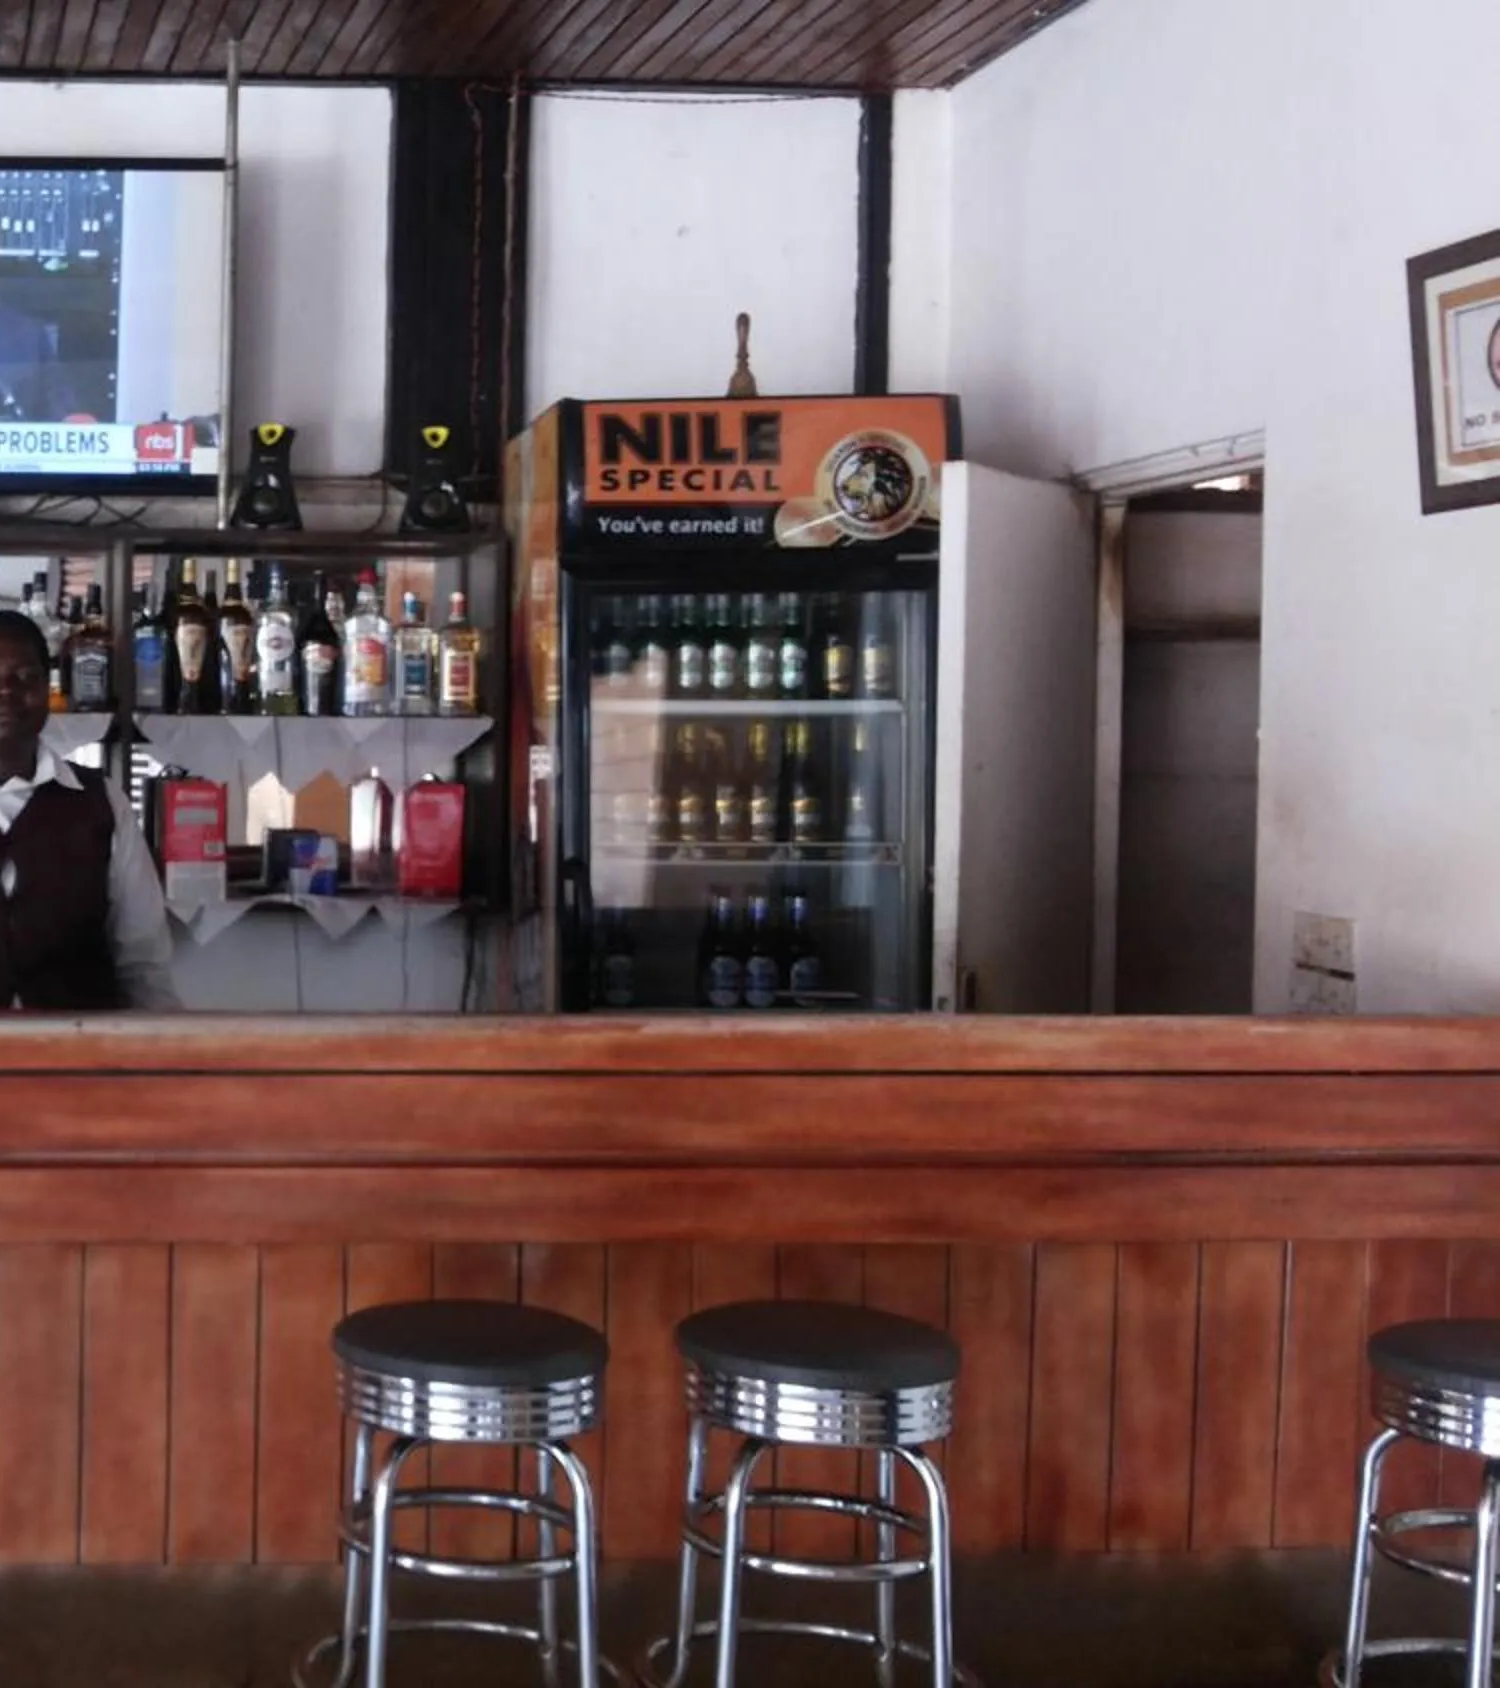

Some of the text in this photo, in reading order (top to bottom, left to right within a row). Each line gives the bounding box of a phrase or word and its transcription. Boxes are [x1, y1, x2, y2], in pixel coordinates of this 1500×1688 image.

[599, 411, 782, 465] NILE
[600, 468, 781, 492] SPECIAL
[598, 516, 764, 534] You've earned it!
